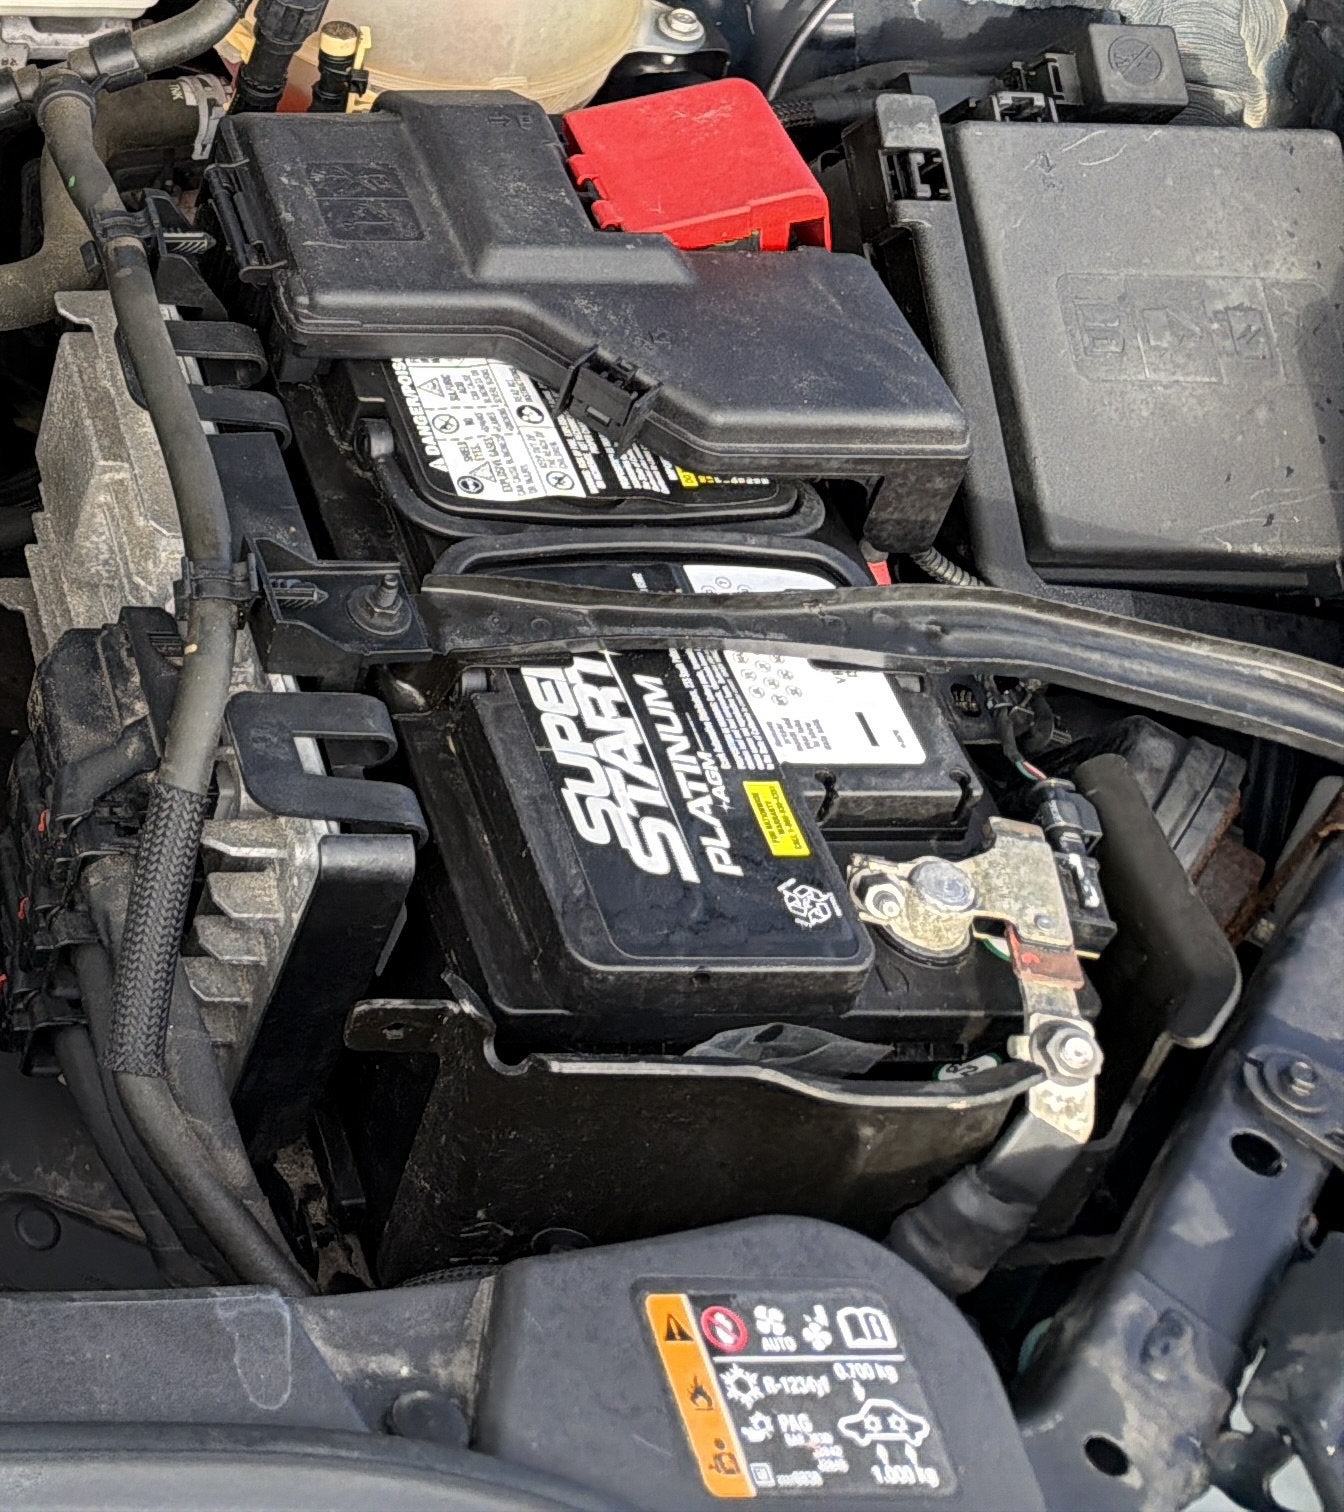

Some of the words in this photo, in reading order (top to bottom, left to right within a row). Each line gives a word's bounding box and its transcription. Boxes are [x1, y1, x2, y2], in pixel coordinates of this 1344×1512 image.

[633, 674, 744, 877] PLATINUM
[761, 1337, 797, 1351] AUTO
[833, 1362, 873, 1379] 0.700
[876, 1362, 898, 1382] kg
[762, 1376, 832, 1398] R-1234yf
[778, 1413, 812, 1432] PAG
[871, 1465, 914, 1483] 1.000
[916, 1465, 939, 1487] kg
